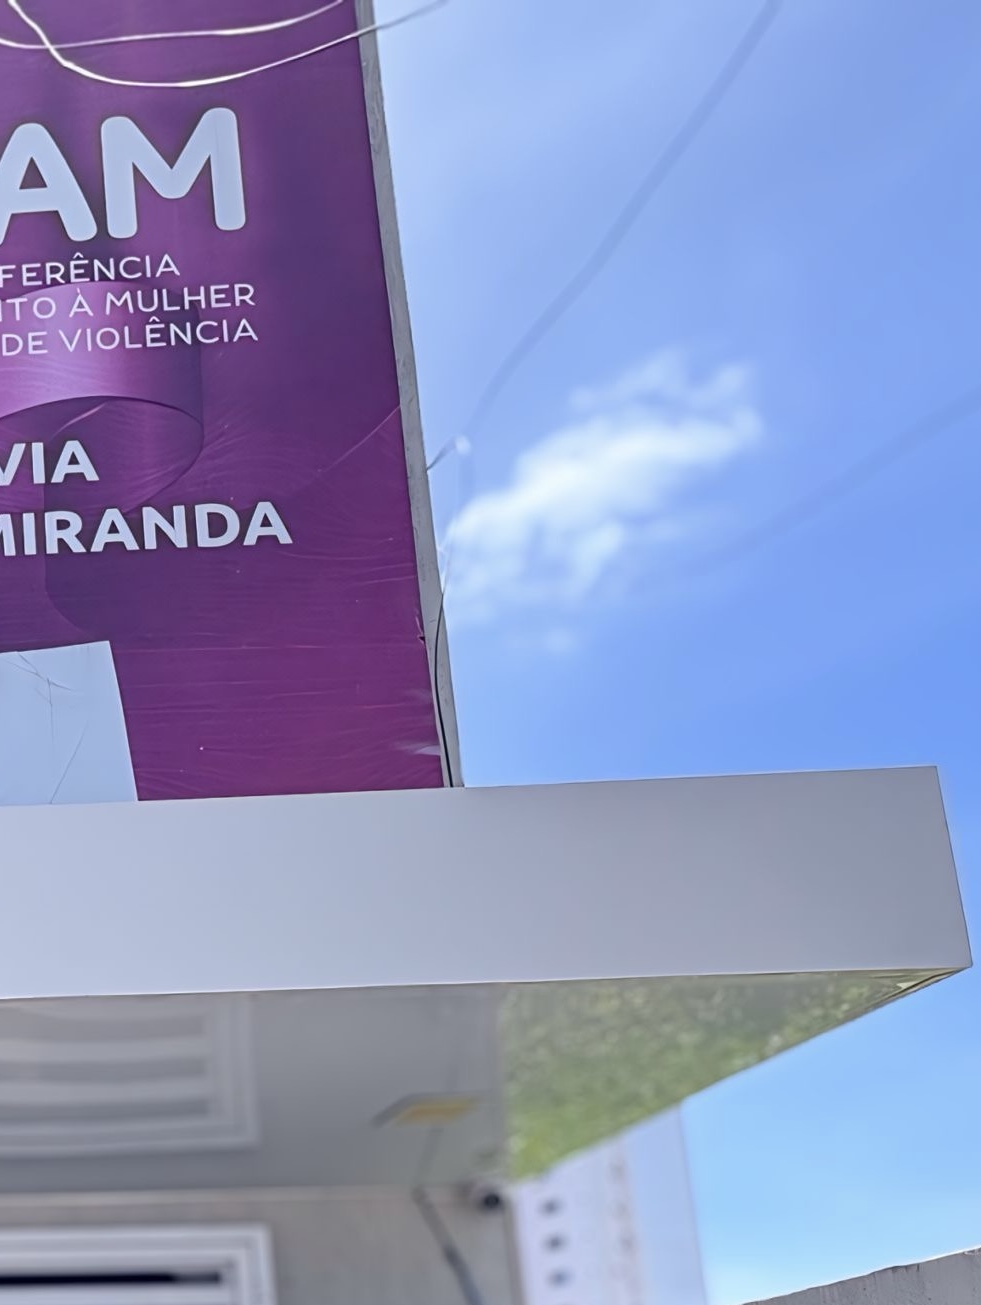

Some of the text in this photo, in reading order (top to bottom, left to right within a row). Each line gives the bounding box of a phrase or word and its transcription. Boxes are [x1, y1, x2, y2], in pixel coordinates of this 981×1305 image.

[69, 287, 93, 318] À
[105, 283, 256, 316] MULHER
[1, 330, 49, 357] DE
[57, 316, 258, 353] VIOLÊNCIA
